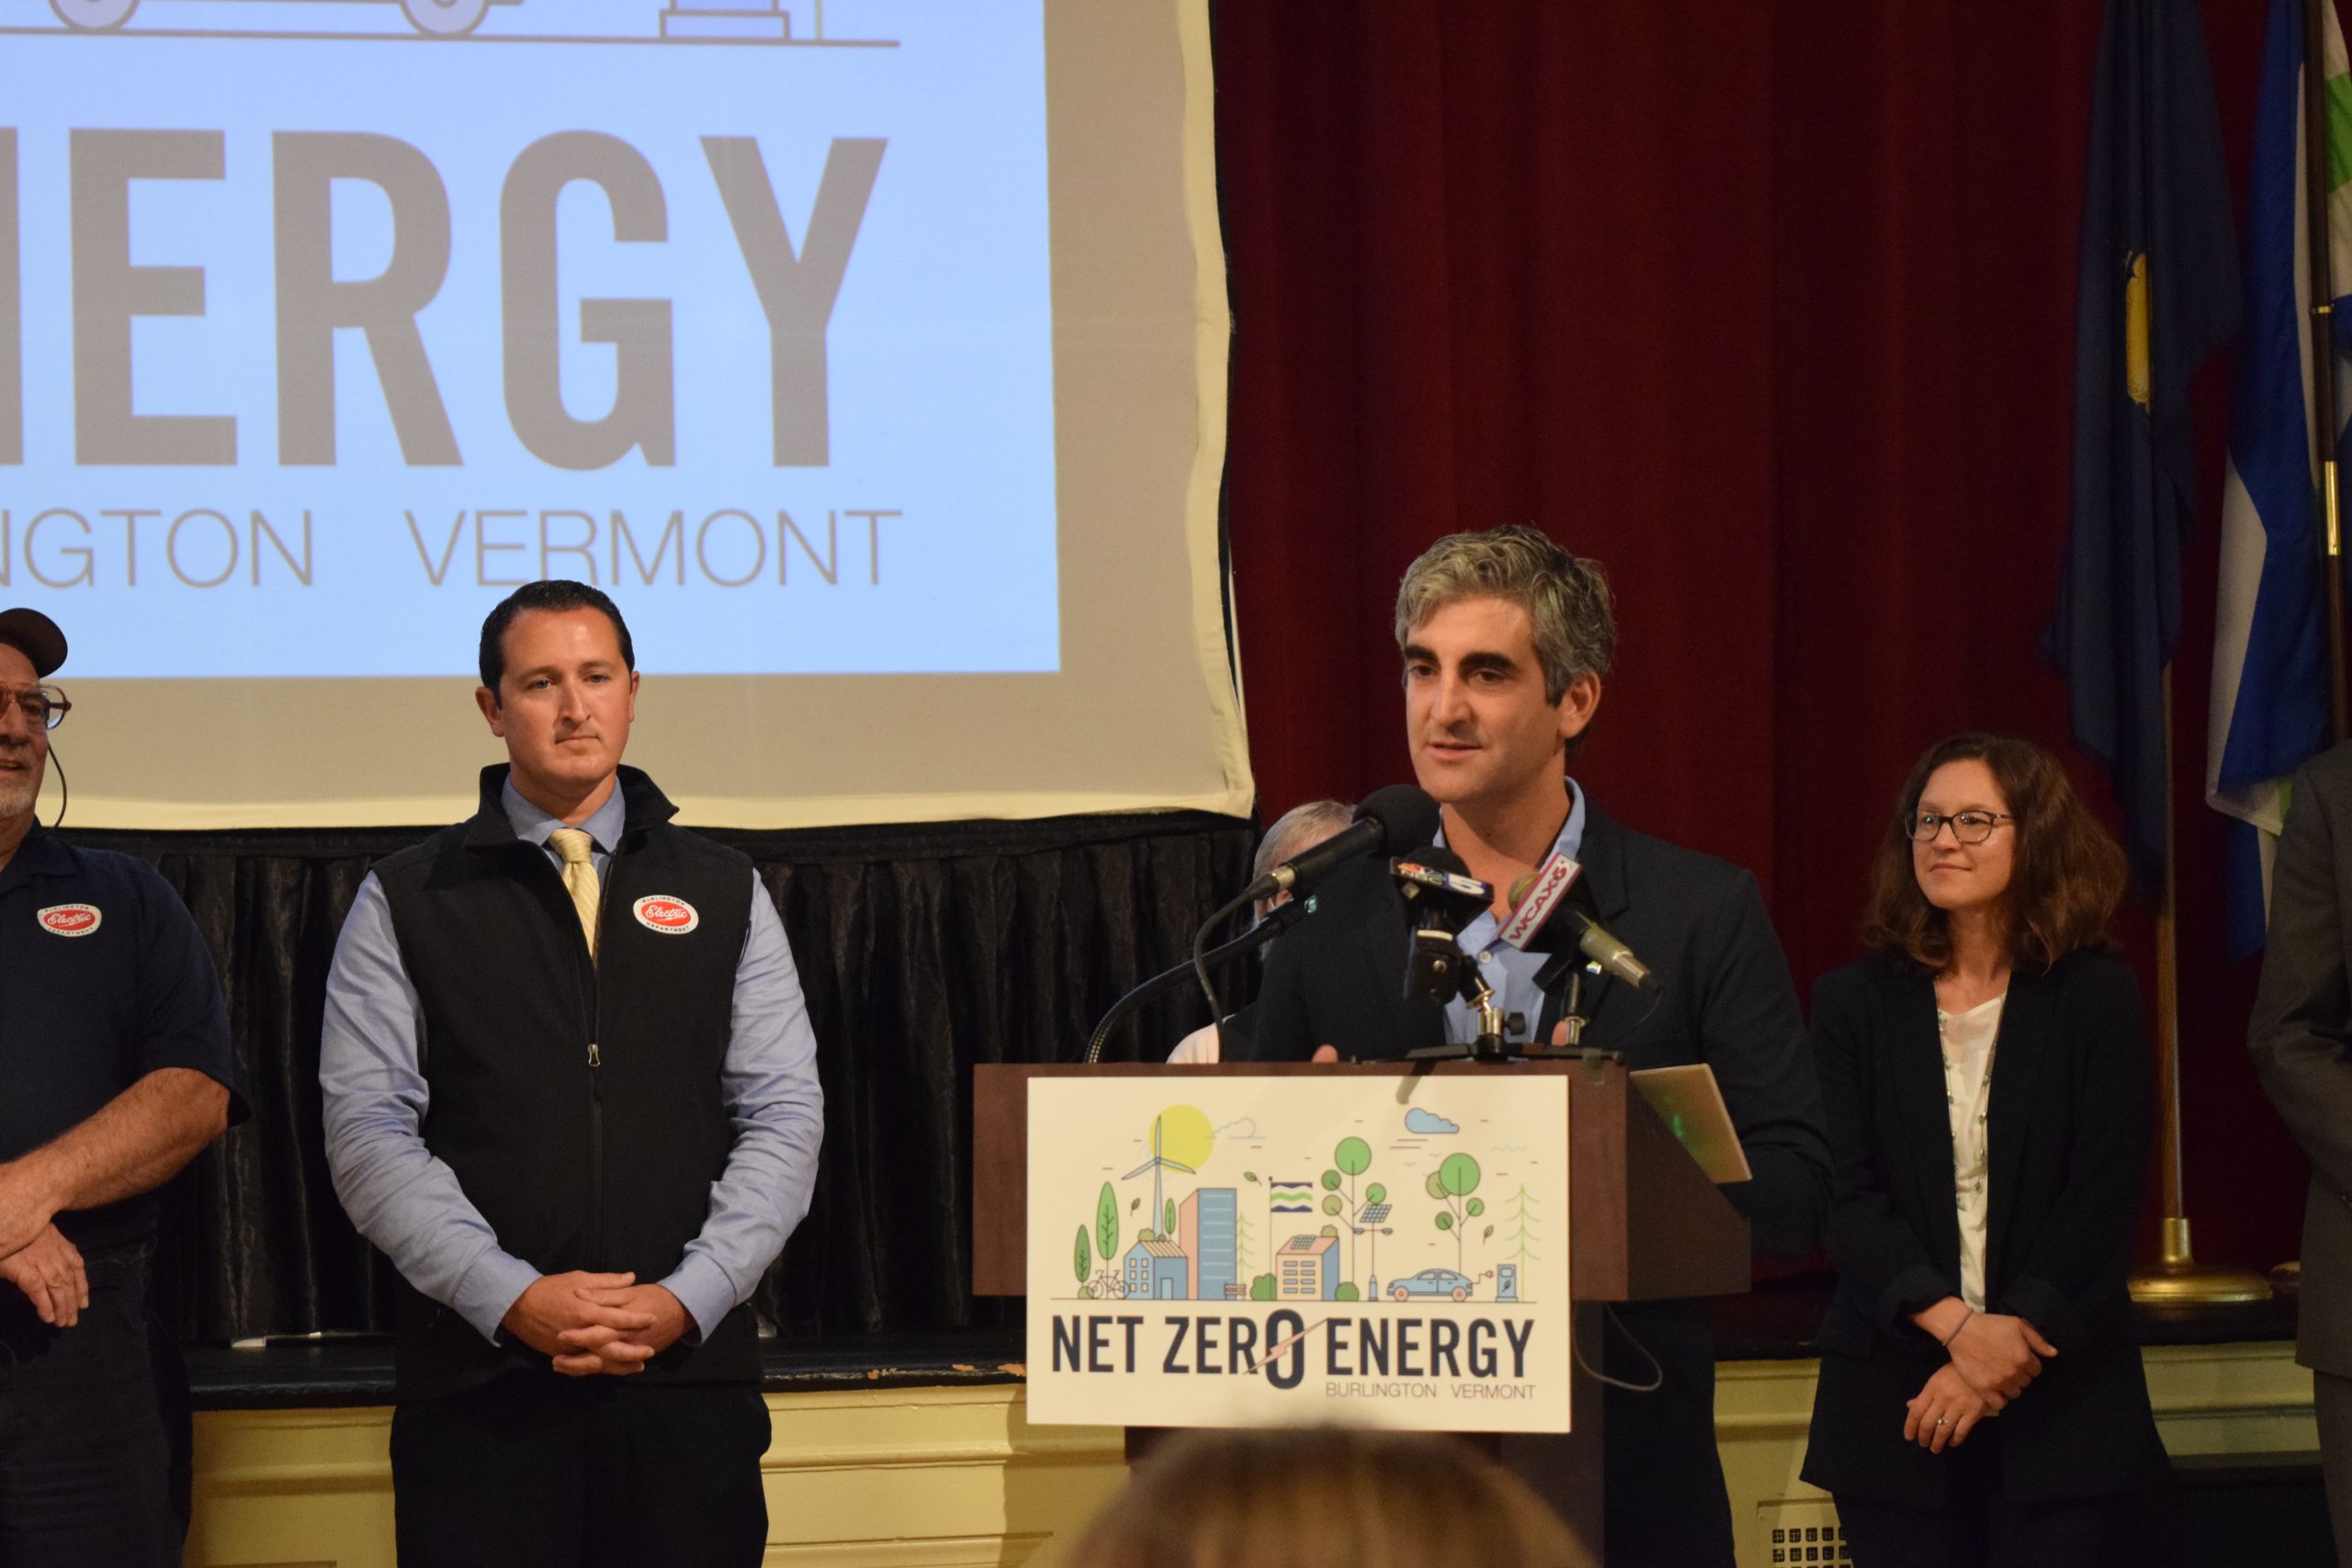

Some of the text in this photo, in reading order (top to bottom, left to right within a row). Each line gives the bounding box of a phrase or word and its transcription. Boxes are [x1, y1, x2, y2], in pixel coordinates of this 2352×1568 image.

[0, 127, 889, 471] ERGY
[0, 508, 903, 588] GTON VERMONT
[645, 904, 688, 919] Electric
[1052, 1308, 1535, 1390] NET ZERO ENERGY
[1325, 1382, 1537, 1400] BURLINGTON VERMONT
